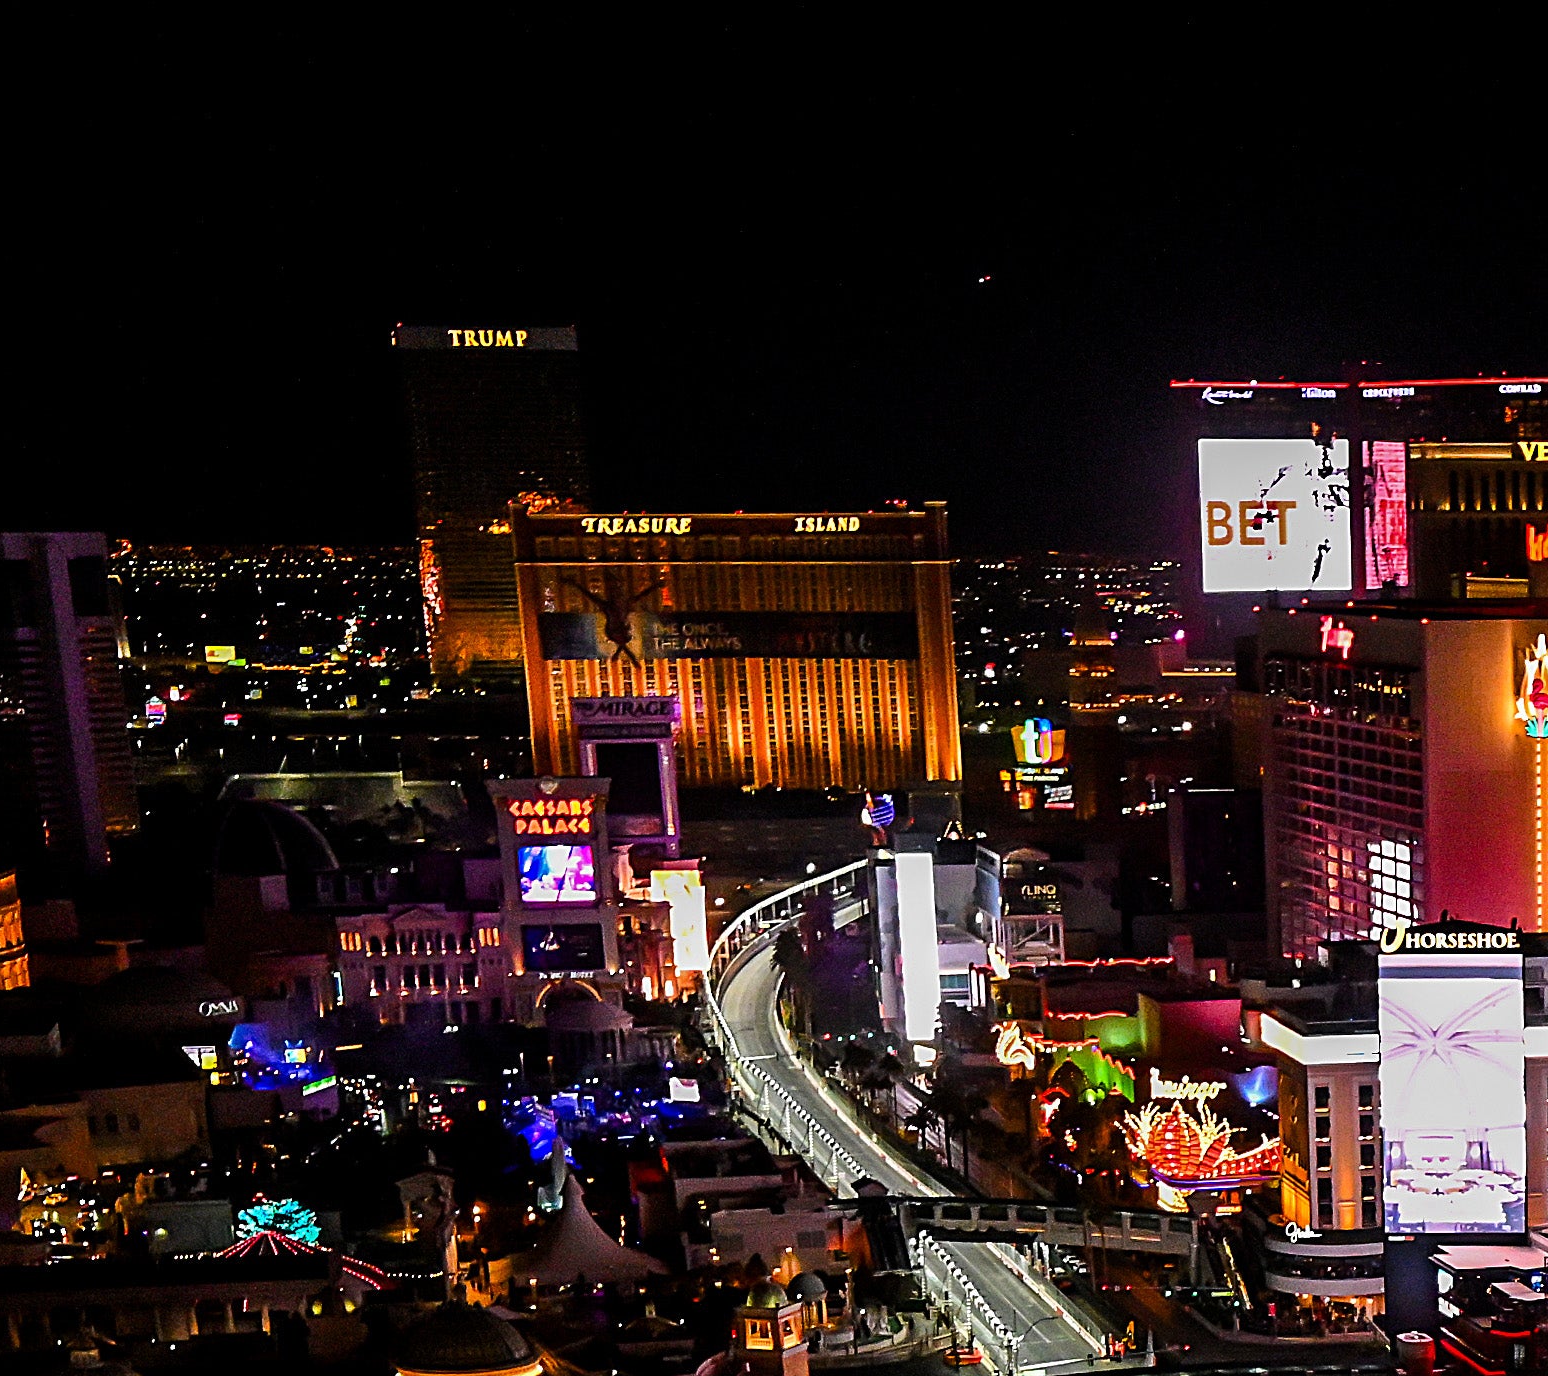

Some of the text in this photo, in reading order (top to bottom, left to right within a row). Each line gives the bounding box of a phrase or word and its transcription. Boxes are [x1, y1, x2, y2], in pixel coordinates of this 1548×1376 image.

[447, 328, 528, 348] TRUMP
[581, 516, 861, 536] TREASURE ISLAND
[1206, 500, 1298, 546] BET
[508, 798, 594, 817] CAESARS
[515, 817, 592, 835] PALACE
[1405, 932, 1521, 949] HORSESHOE
